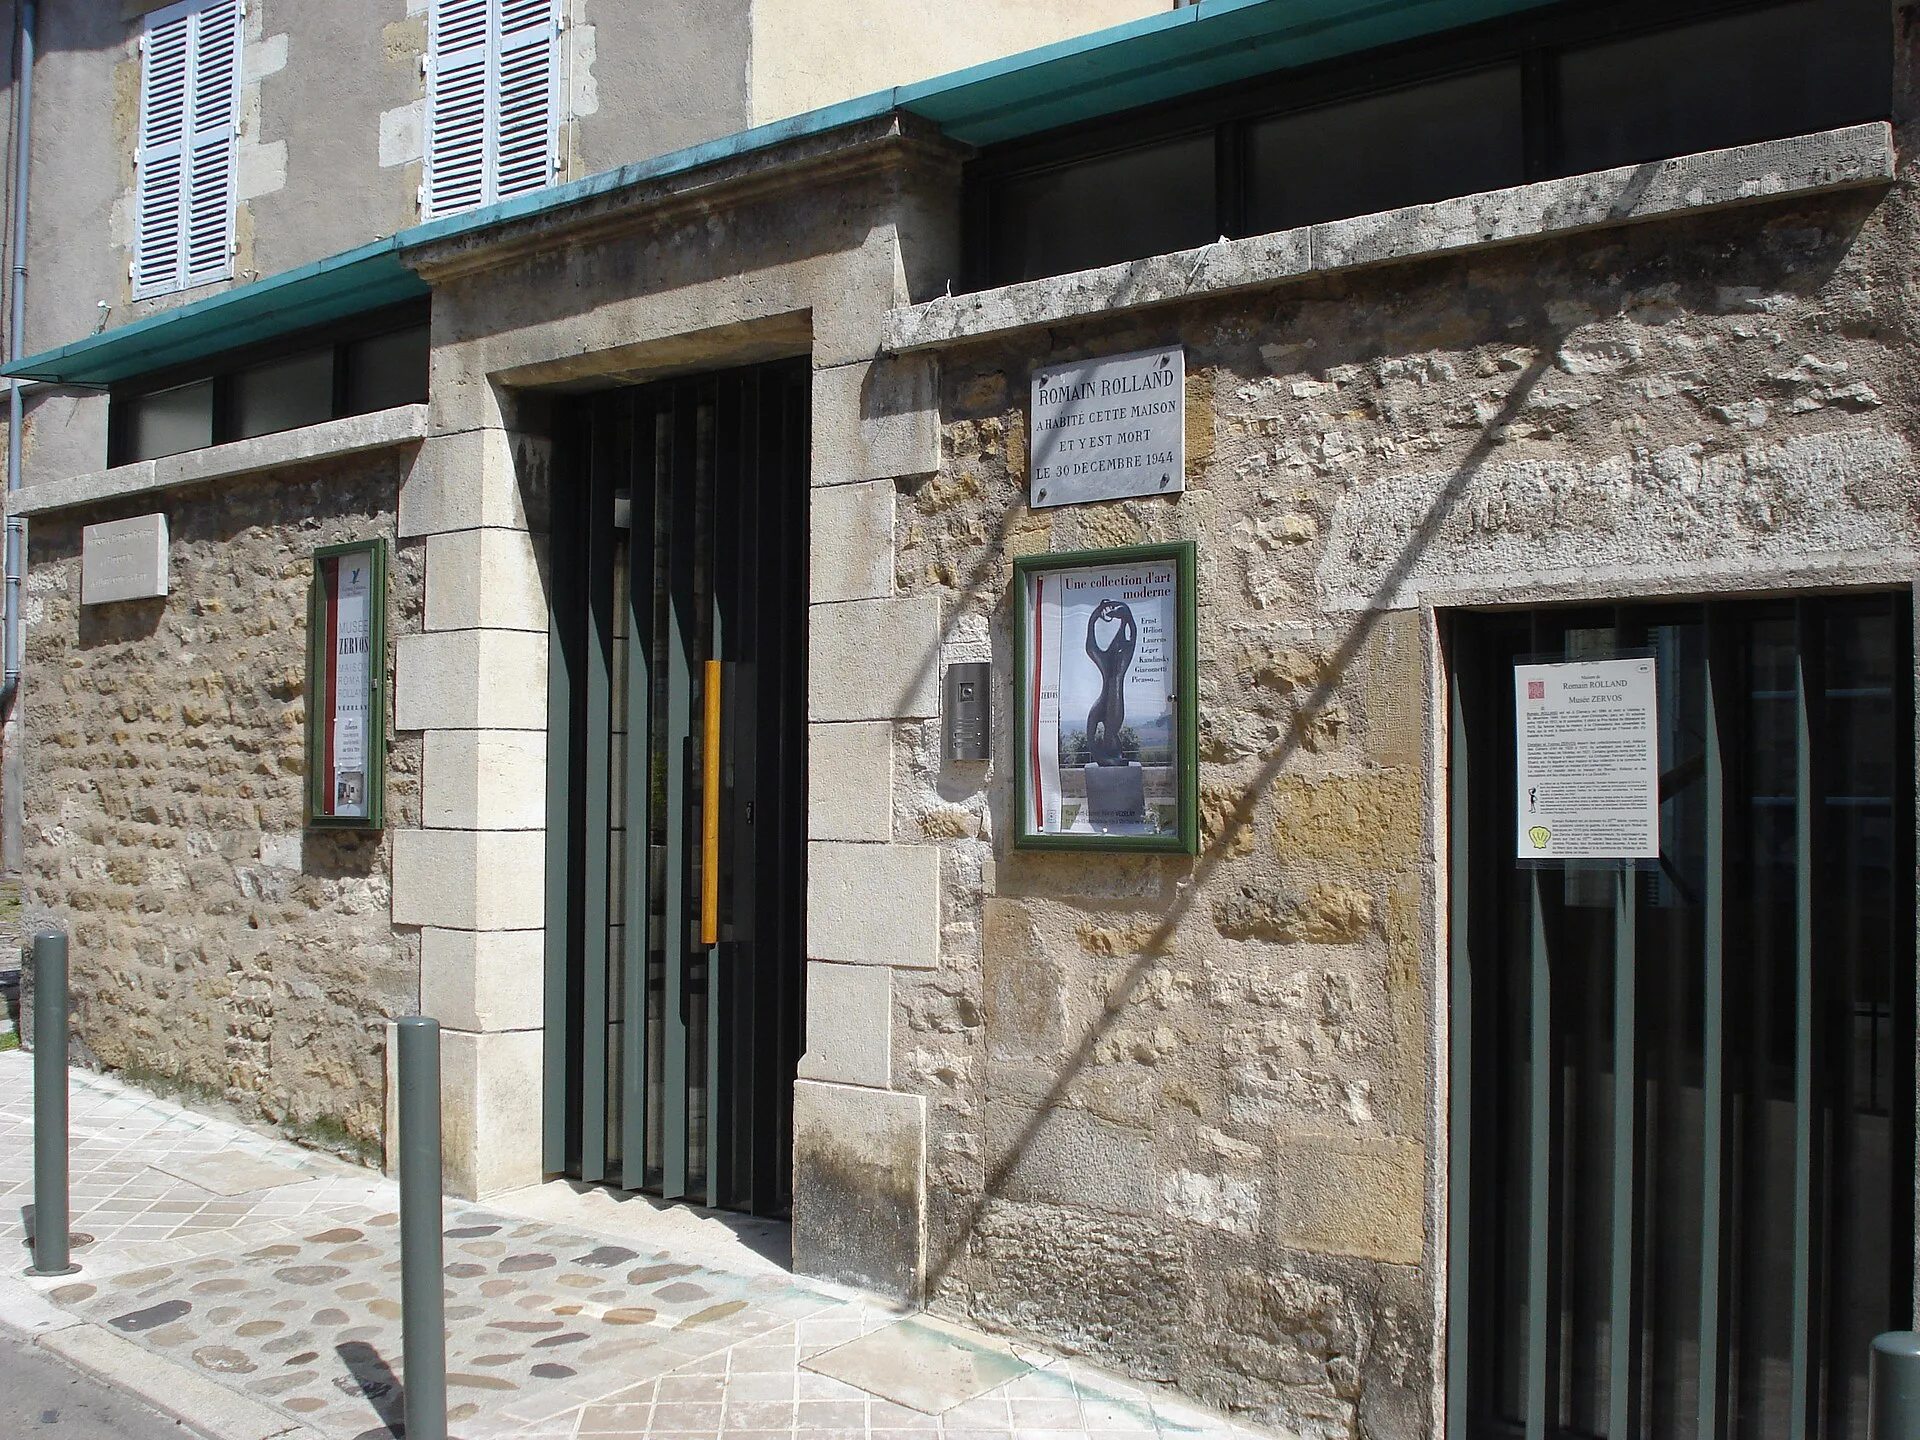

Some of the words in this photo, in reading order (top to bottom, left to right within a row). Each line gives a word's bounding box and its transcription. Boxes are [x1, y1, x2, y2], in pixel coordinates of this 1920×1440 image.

[1038, 381, 1096, 407] ROMAIN
[1100, 369, 1174, 397] ROLLAND
[1088, 407, 1127, 424] CETTE
[1130, 400, 1176, 418] MAISON
[1059, 439, 1074, 452] ET
[1078, 437, 1086, 449] Y
[1089, 434, 1112, 449] EST
[1117, 428, 1151, 445] MORT
[1036, 467, 1050, 480] LE
[1055, 464, 1070, 477] 30
[1146, 450, 1174, 466] 1944
[1065, 577, 1087, 590] Une
[1090, 574, 1142, 589] collection
[1145, 571, 1171, 584] d'art
[1123, 586, 1171, 599] moderne
[338, 636, 369, 655] ZERVOS
[1562, 682, 1588, 690] Romain
[1589, 679, 1628, 689] ROLLAND
[1568, 696, 1590, 704] Musée
[1591, 694, 1623, 703] ZERVOS
